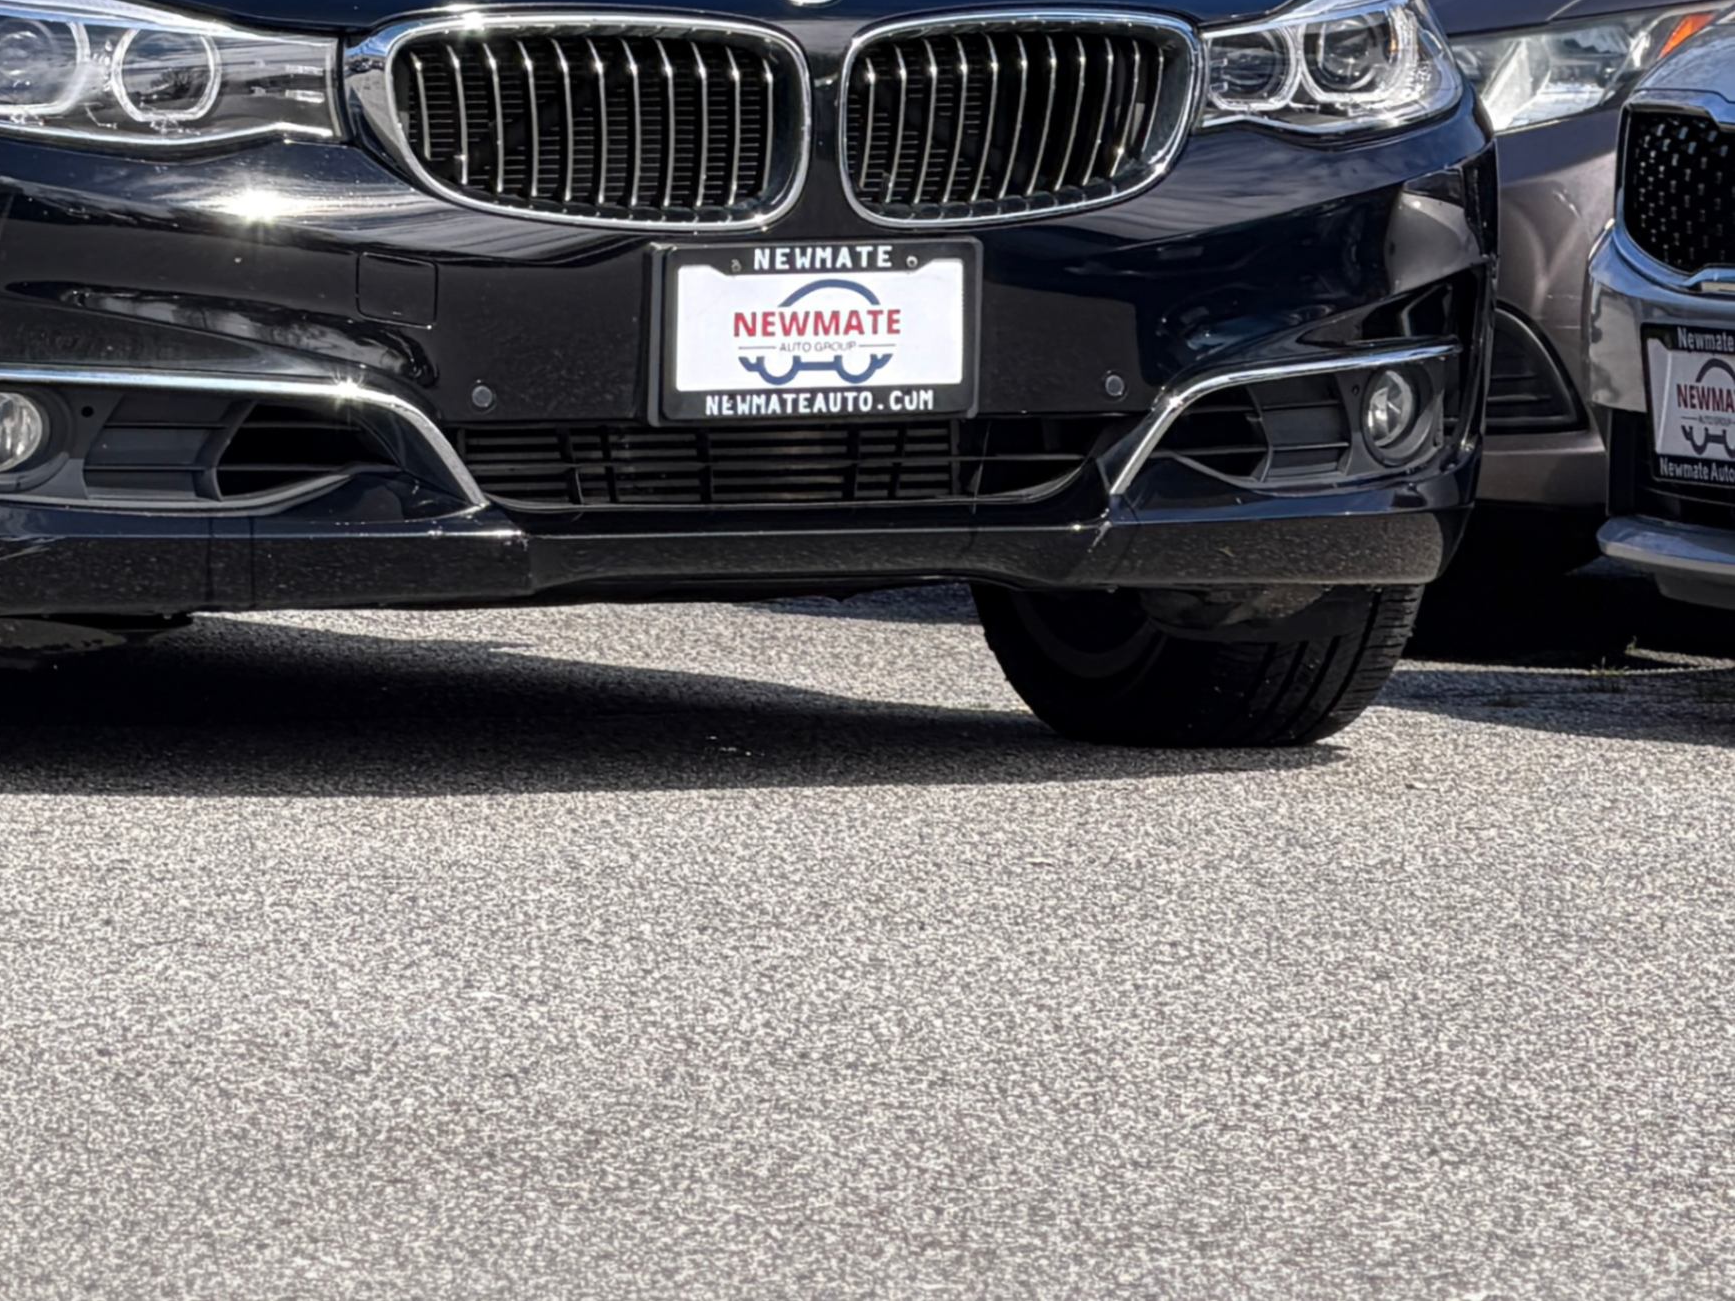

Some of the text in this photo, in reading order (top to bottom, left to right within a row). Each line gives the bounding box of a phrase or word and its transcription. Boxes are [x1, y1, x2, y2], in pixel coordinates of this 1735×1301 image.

[754, 245, 892, 270] NEWMATE
[733, 309, 901, 337] NEWMATE
[779, 340, 856, 352] AUTO GROUP
[1677, 327, 1735, 352] Newmate
[705, 389, 934, 415] NEWMATEAUTO.COM
[1676, 383, 1735, 413] NEWMA
[1660, 457, 1709, 480] Newmate
